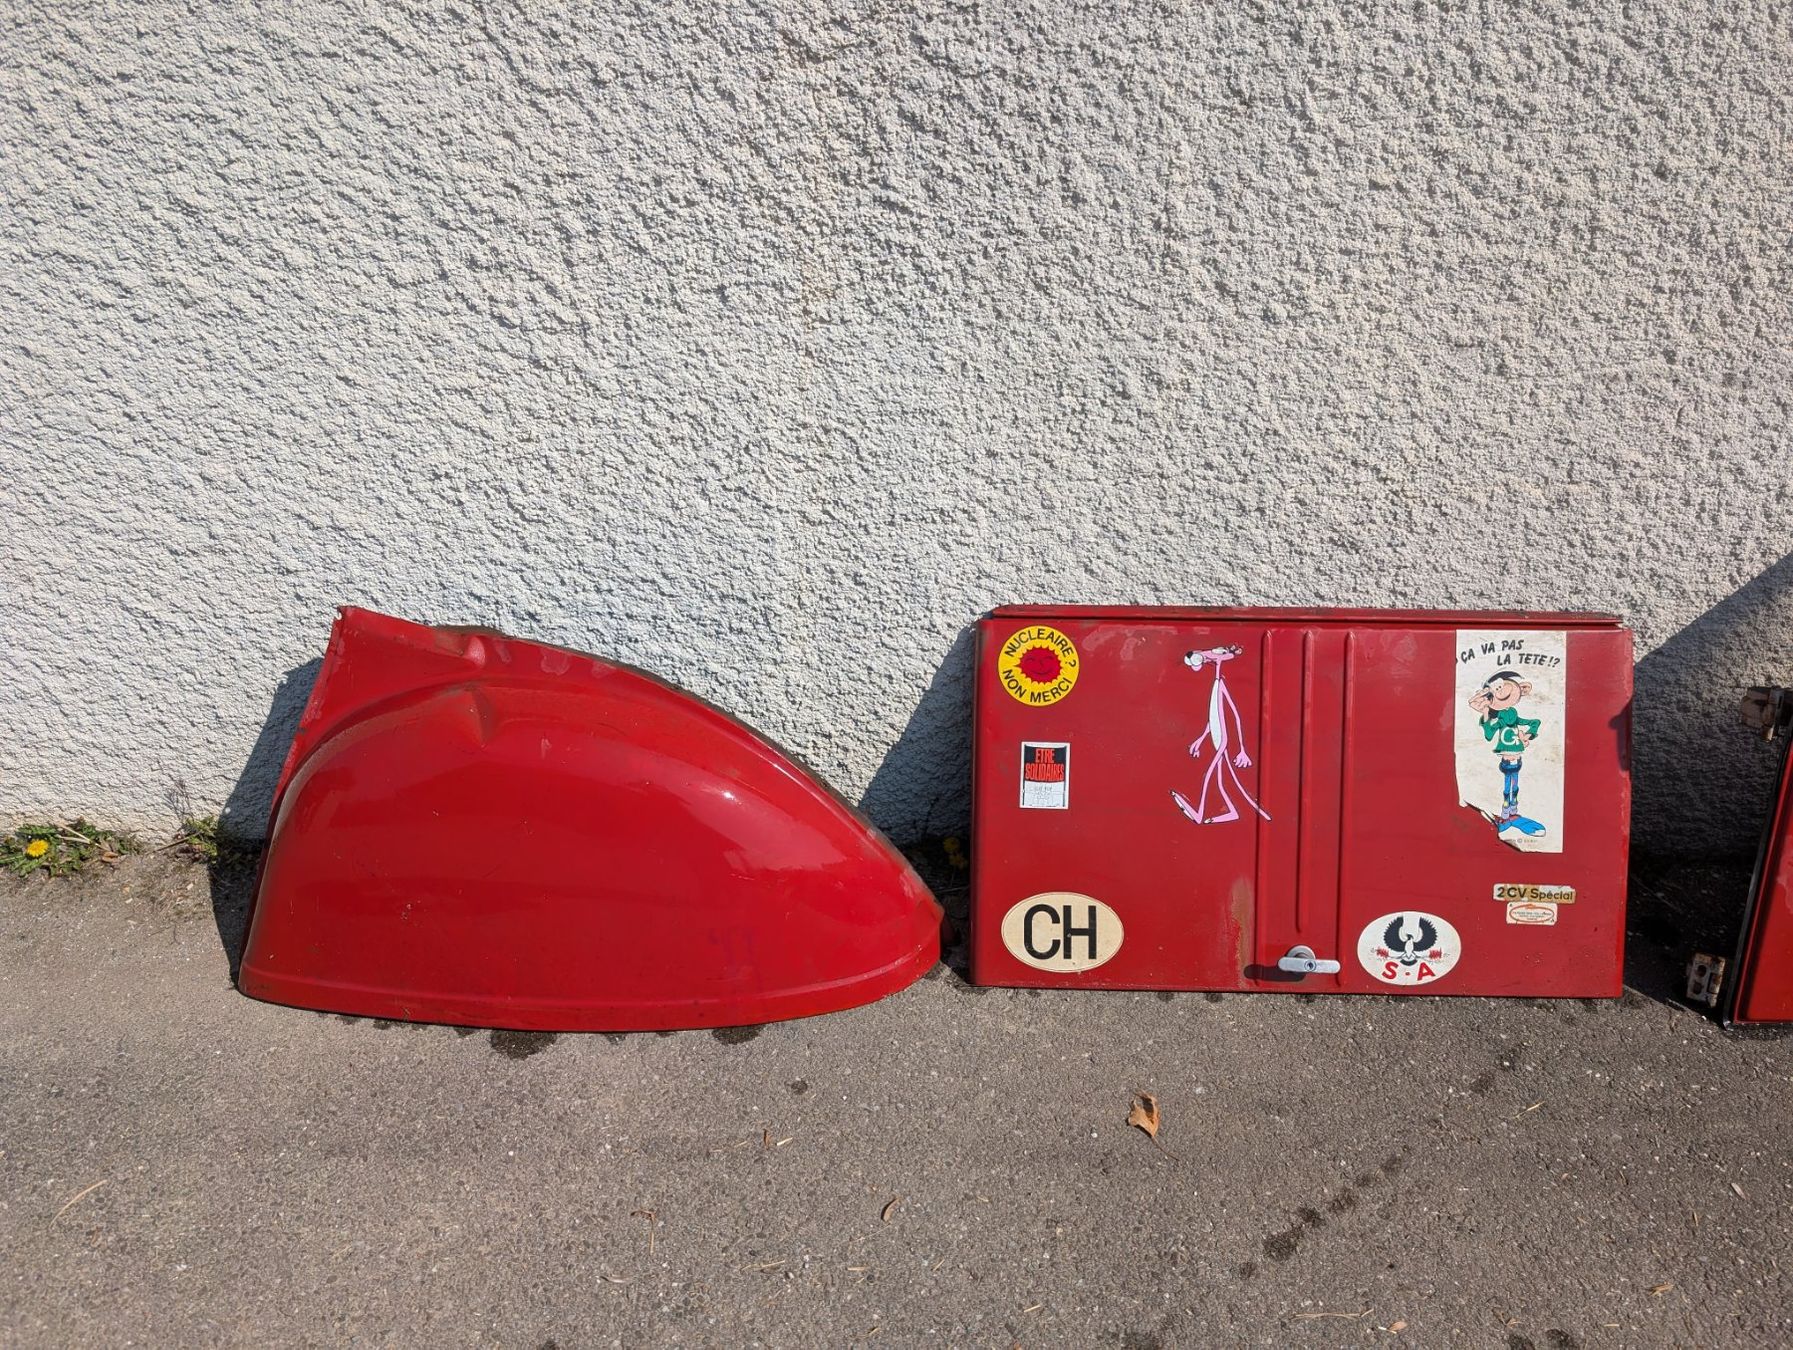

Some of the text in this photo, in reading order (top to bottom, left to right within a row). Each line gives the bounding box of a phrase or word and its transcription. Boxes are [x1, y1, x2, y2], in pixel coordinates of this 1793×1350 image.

[1481, 642, 1496, 655] VA
[1501, 639, 1525, 651] PAS
[1497, 655, 1511, 666] LA
[1003, 669, 1073, 703] NON MERCI
[1025, 762, 1065, 782] SOLIDAIRES
[1530, 888, 1573, 901] Spécial
[1023, 903, 1097, 960] CH
